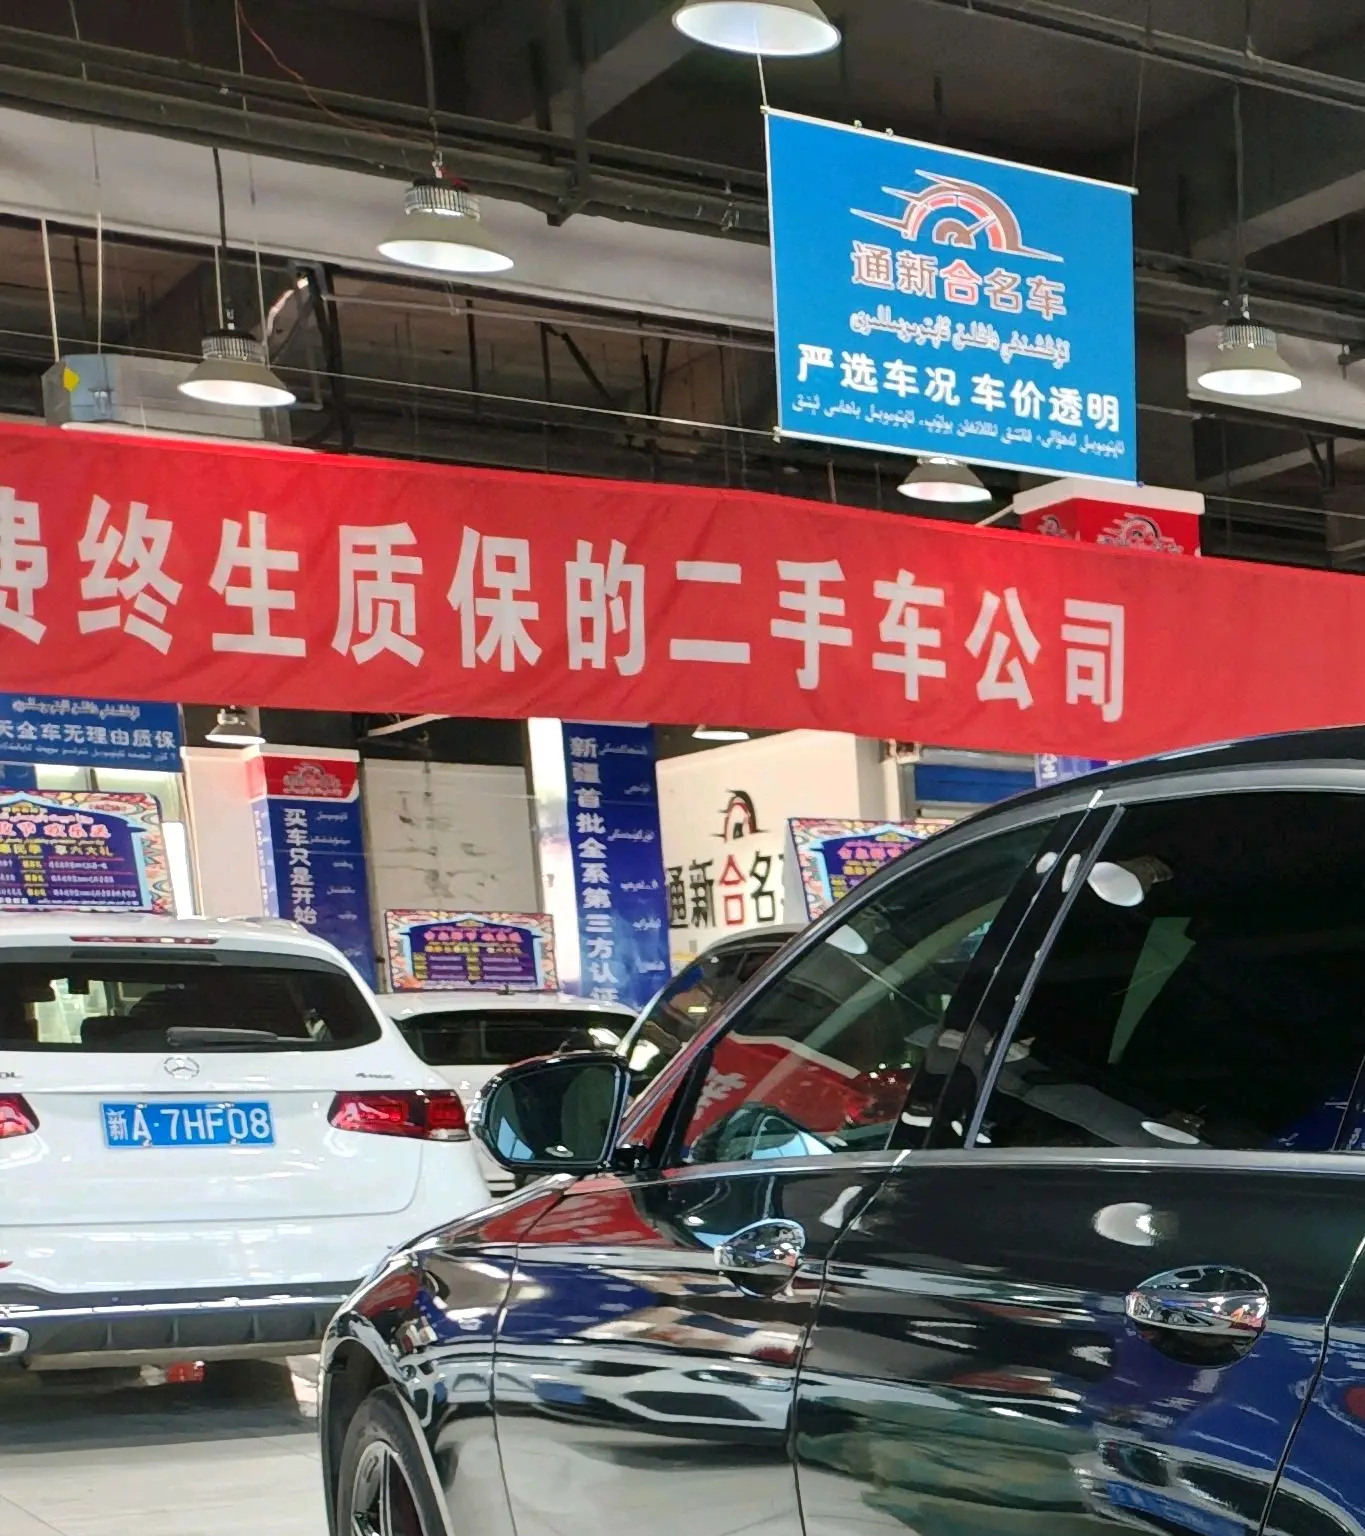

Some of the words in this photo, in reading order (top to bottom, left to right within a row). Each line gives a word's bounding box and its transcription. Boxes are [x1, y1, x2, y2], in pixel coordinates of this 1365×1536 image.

[851, 240, 1067, 322] 通新合名车
[797, 343, 961, 407] 严选车况
[970, 373, 1121, 433] 车价透明
[664, 850, 784, 930] 通新合名
